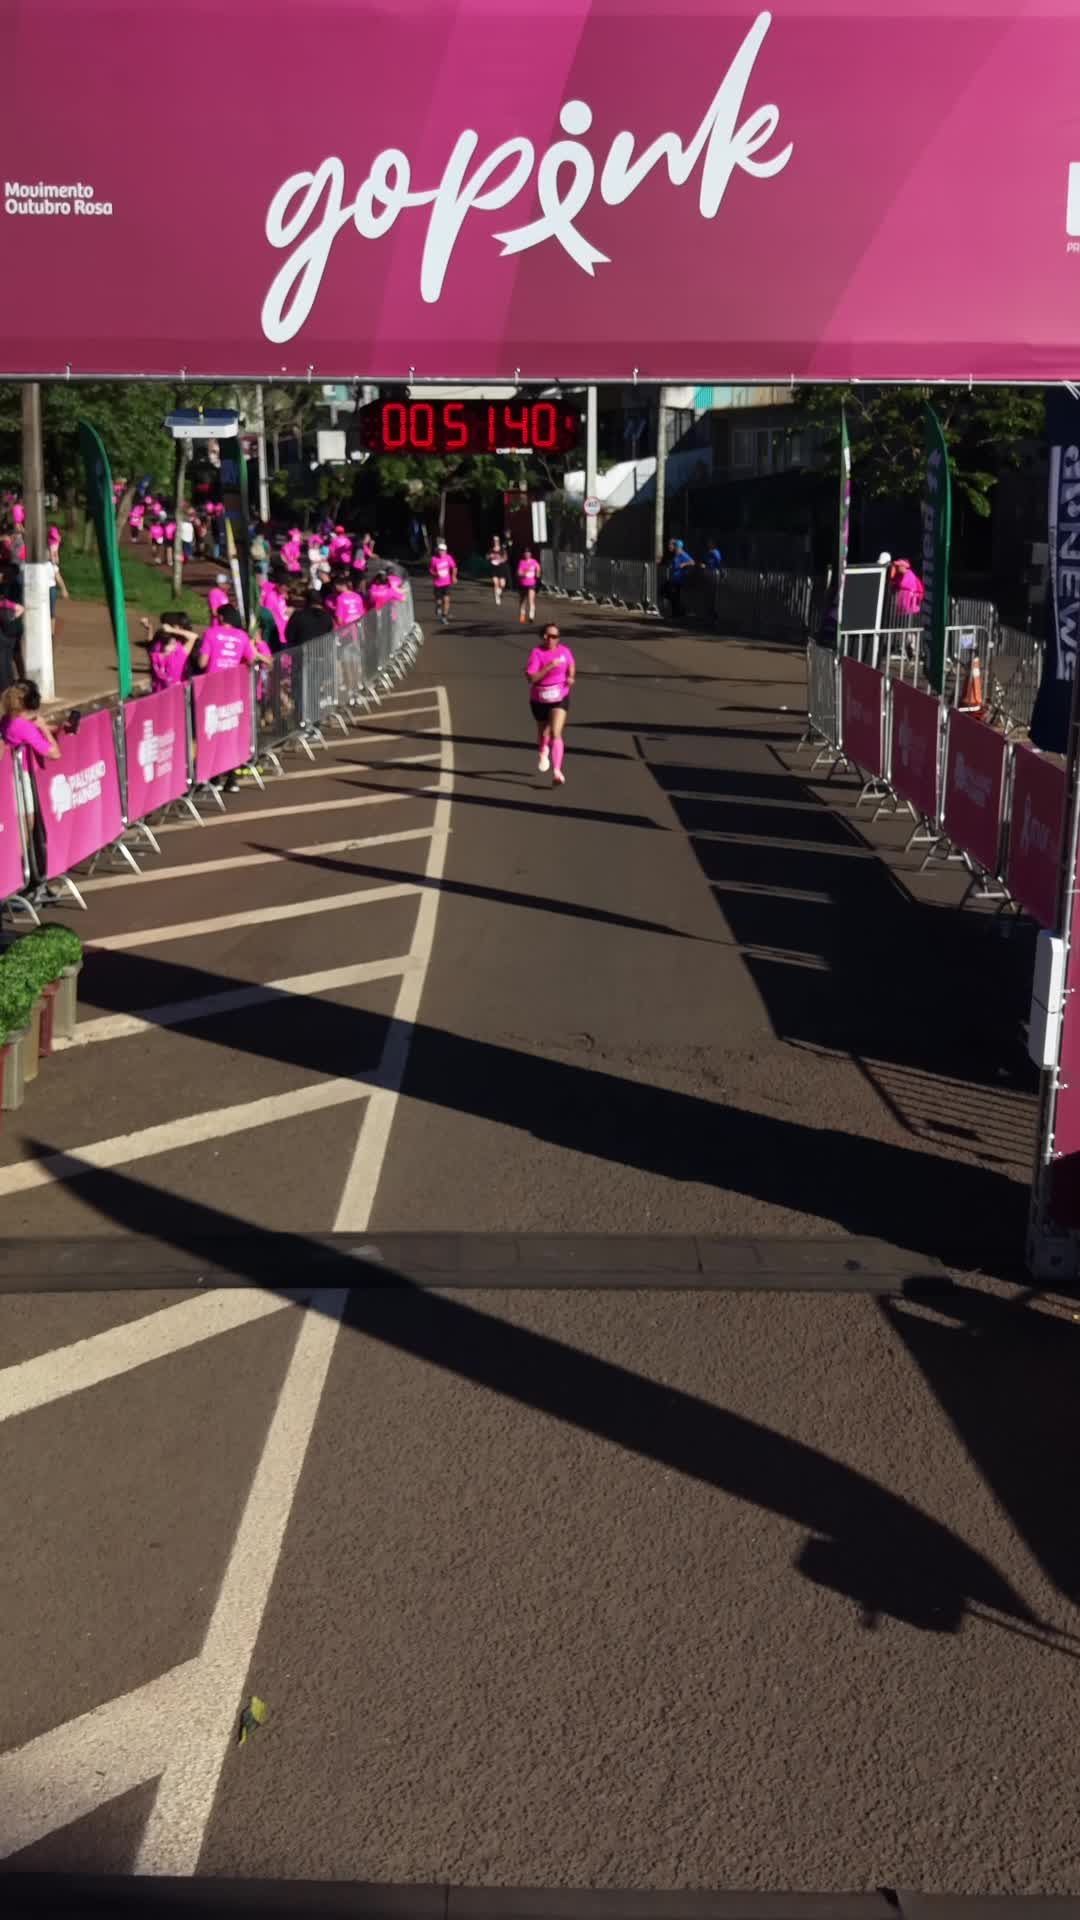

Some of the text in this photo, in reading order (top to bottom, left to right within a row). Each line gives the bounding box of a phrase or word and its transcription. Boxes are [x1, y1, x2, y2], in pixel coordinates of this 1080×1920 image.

[5, 182, 94, 198] Movimento
[5, 198, 113, 215] Outubro Rosa
